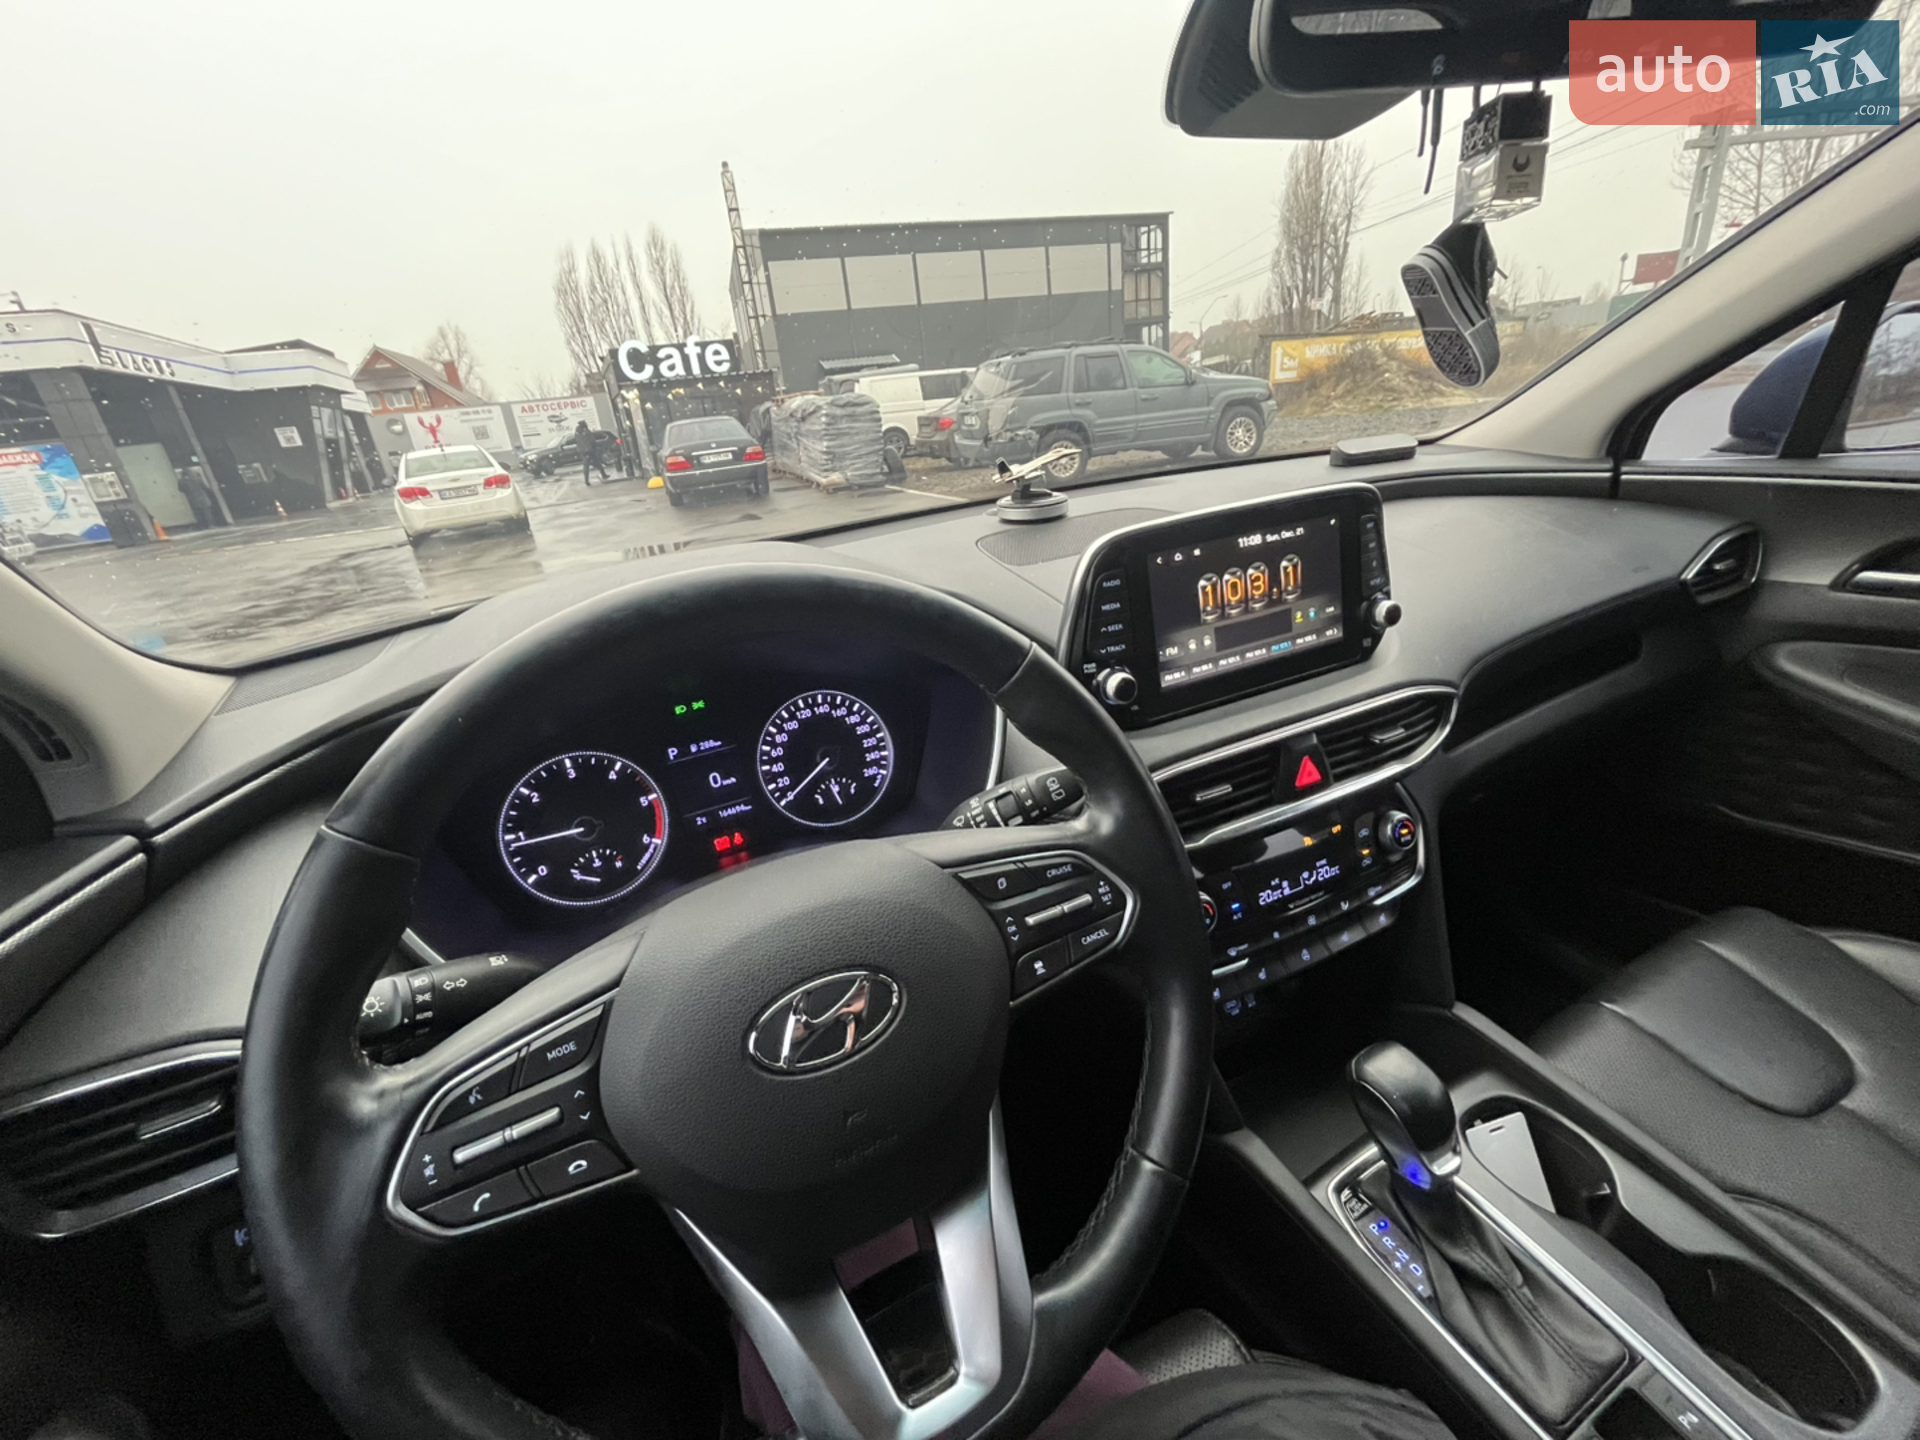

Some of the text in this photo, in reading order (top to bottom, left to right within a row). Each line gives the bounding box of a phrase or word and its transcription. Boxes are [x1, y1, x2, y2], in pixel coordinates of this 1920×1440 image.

[618, 335, 731, 380] Cafe
[521, 400, 588, 414] АВТОСЕРВІС
[1102, 579, 1121, 587] RADIO
[1204, 564, 1295, 608] 103.1
[1101, 602, 1121, 611] MEDIA
[1107, 624, 1123, 632] SEEK
[1107, 644, 1126, 653] TRACK
[1165, 645, 1178, 657] FM
[796, 709, 812, 719] 120
[814, 704, 830, 715] 140
[831, 707, 847, 718] 160
[845, 714, 860, 725] 180
[783, 720, 799, 731] 100
[855, 724, 871, 735] 200
[775, 733, 788, 743] 80
[862, 737, 877, 748] 220
[667, 747, 678, 760] P
[771, 747, 783, 757] 60
[771, 762, 784, 773] 40
[567, 768, 577, 779] 3
[608, 770, 617, 780] 4
[709, 772, 721, 788] 0
[777, 776, 790, 787] 20
[530, 791, 540, 803] 2
[639, 796, 649, 807] 5
[518, 831, 526, 841] 1
[642, 833, 650, 844] 6
[537, 865, 548, 876] 0
[1046, 864, 1073, 878] CRUISE
[1098, 885, 1110, 895] RES
[1101, 893, 1112, 903] SET
[1007, 924, 1017, 933] OK
[1081, 928, 1110, 946] CANCEL
[415, 1011, 433, 1021] AUTO
[546, 1040, 577, 1061] MODE
[1369, 1223, 1380, 1236] P
[1382, 1236, 1396, 1250] R
[1395, 1248, 1410, 1263] N
[1409, 1263, 1423, 1277] D
